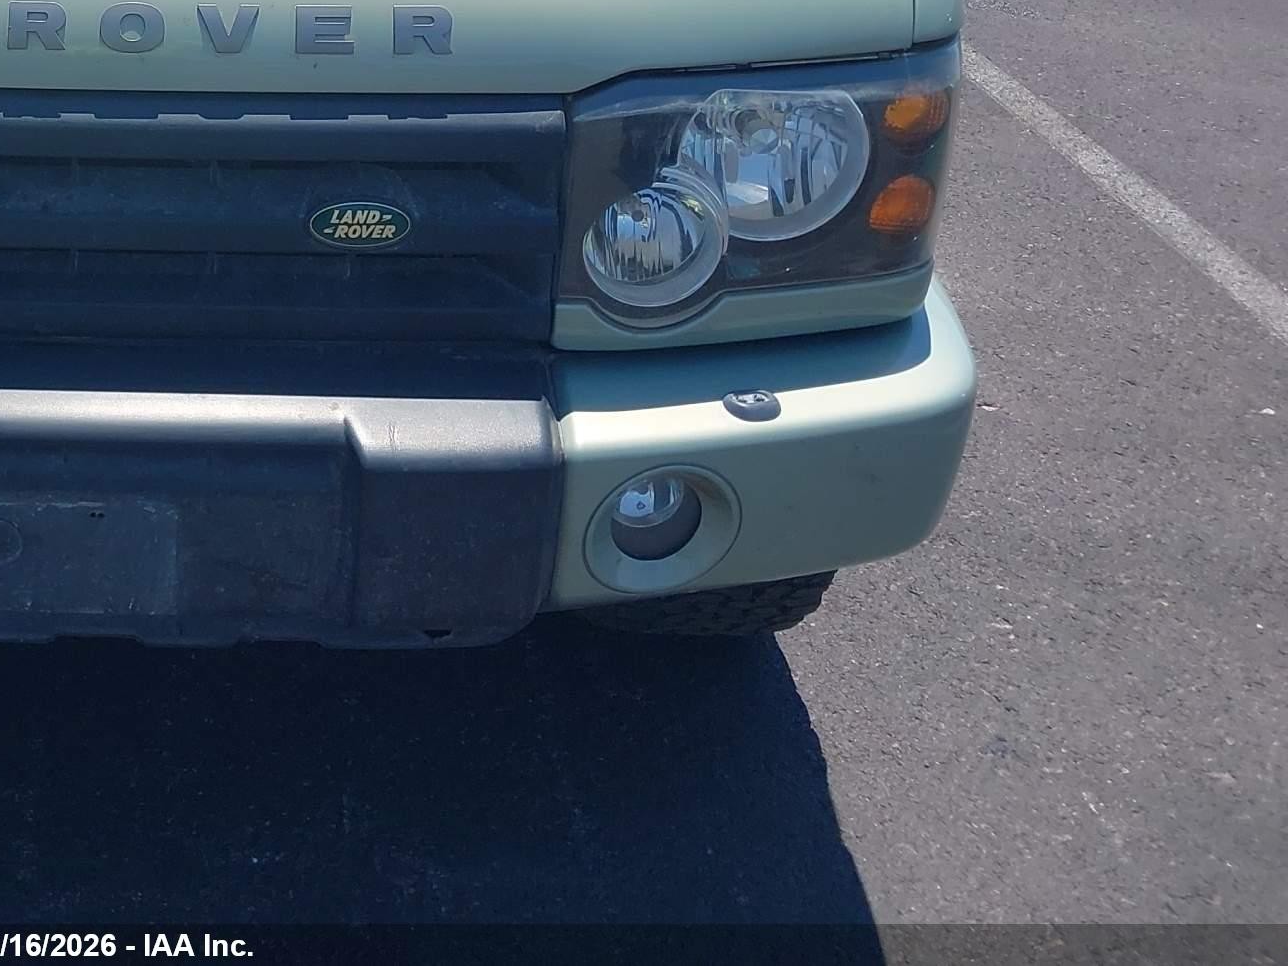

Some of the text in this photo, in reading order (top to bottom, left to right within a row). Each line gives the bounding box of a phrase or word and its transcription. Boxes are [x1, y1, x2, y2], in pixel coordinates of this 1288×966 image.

[6, 0, 454, 55] ROVER
[330, 209, 381, 224] LAND
[333, 224, 396, 239] ROVER
